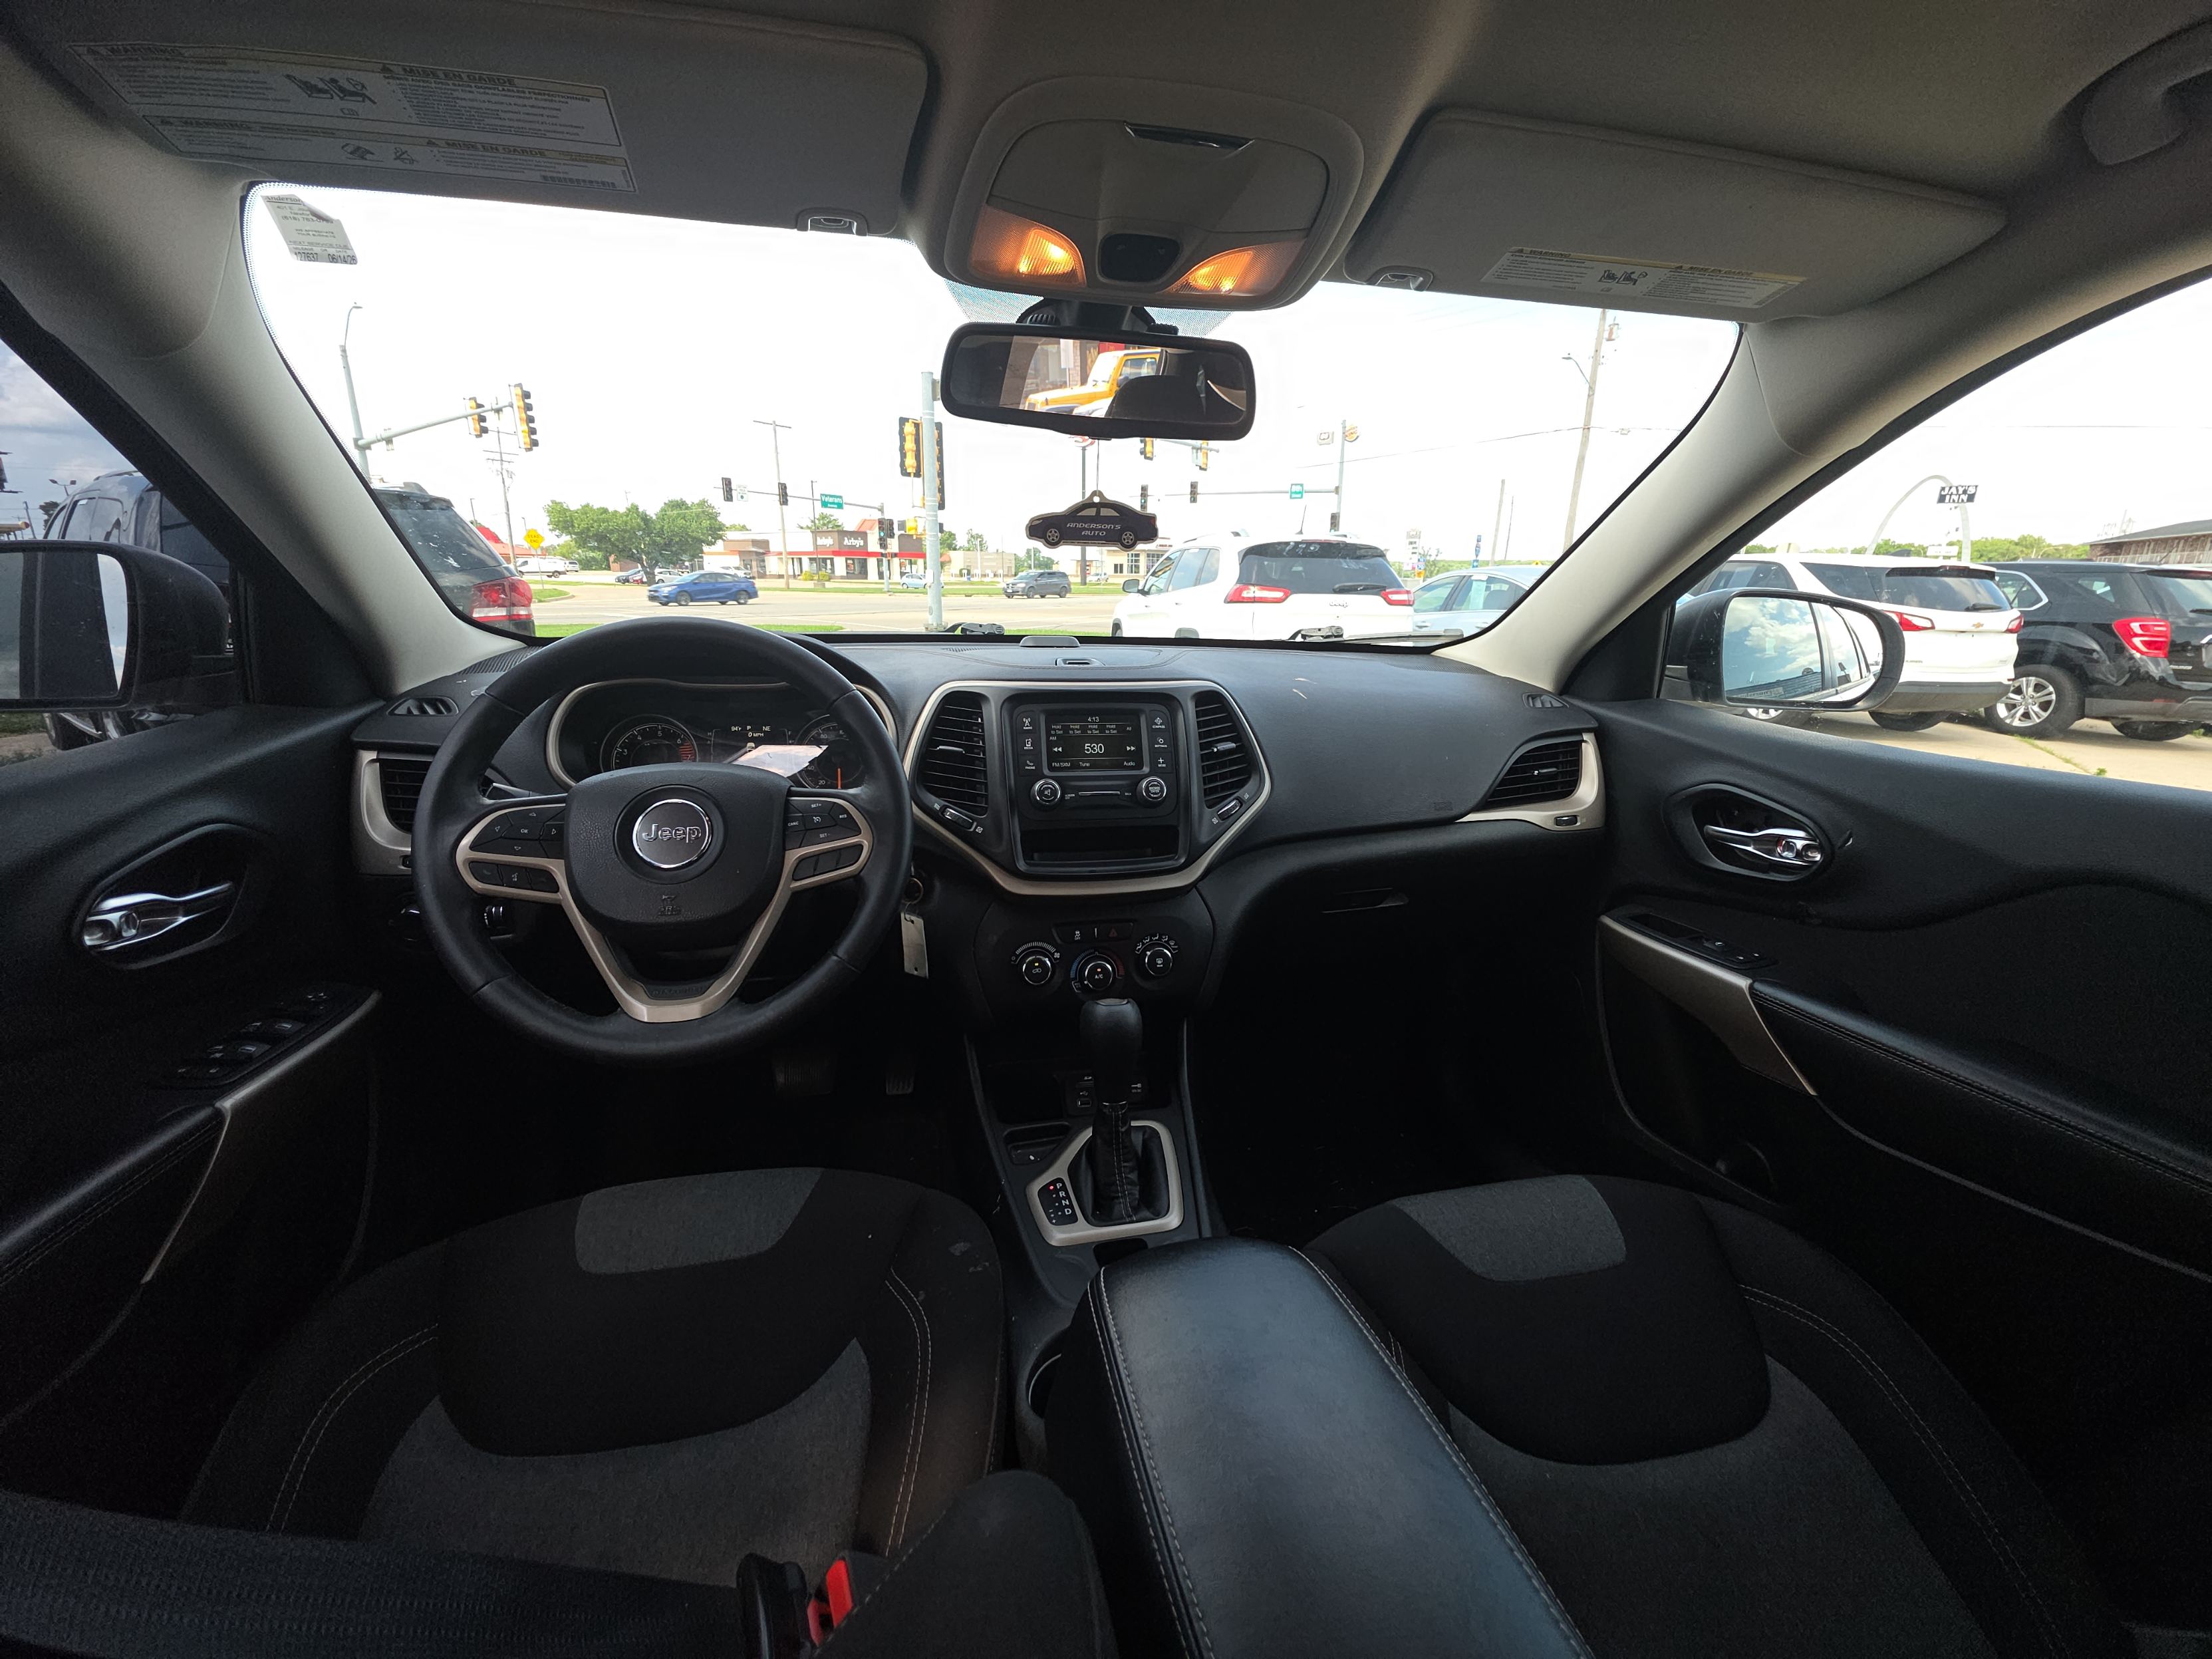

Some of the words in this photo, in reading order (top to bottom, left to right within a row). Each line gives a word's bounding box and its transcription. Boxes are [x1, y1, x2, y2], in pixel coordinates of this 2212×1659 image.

[402, 67, 443, 78] MISE
[444, 71, 464, 81] EN
[467, 75, 516, 86] GARDE
[445, 141, 479, 152] MISE
[482, 144, 500, 153] EN
[502, 146, 546, 157] GARDE
[295, 251, 319, 262] 127637
[328, 253, 357, 265] 06/14/26
[1530, 249, 1572, 258] WARNING
[1941, 485, 1976, 495] JAY'S
[821, 494, 843, 504] Veterans
[1944, 494, 1969, 503] INN
[1066, 522, 1122, 530] ANDERSON'S
[843, 537, 864, 547] Arby's
[1085, 743, 1105, 754] 530
[642, 824, 702, 843] Jeep
